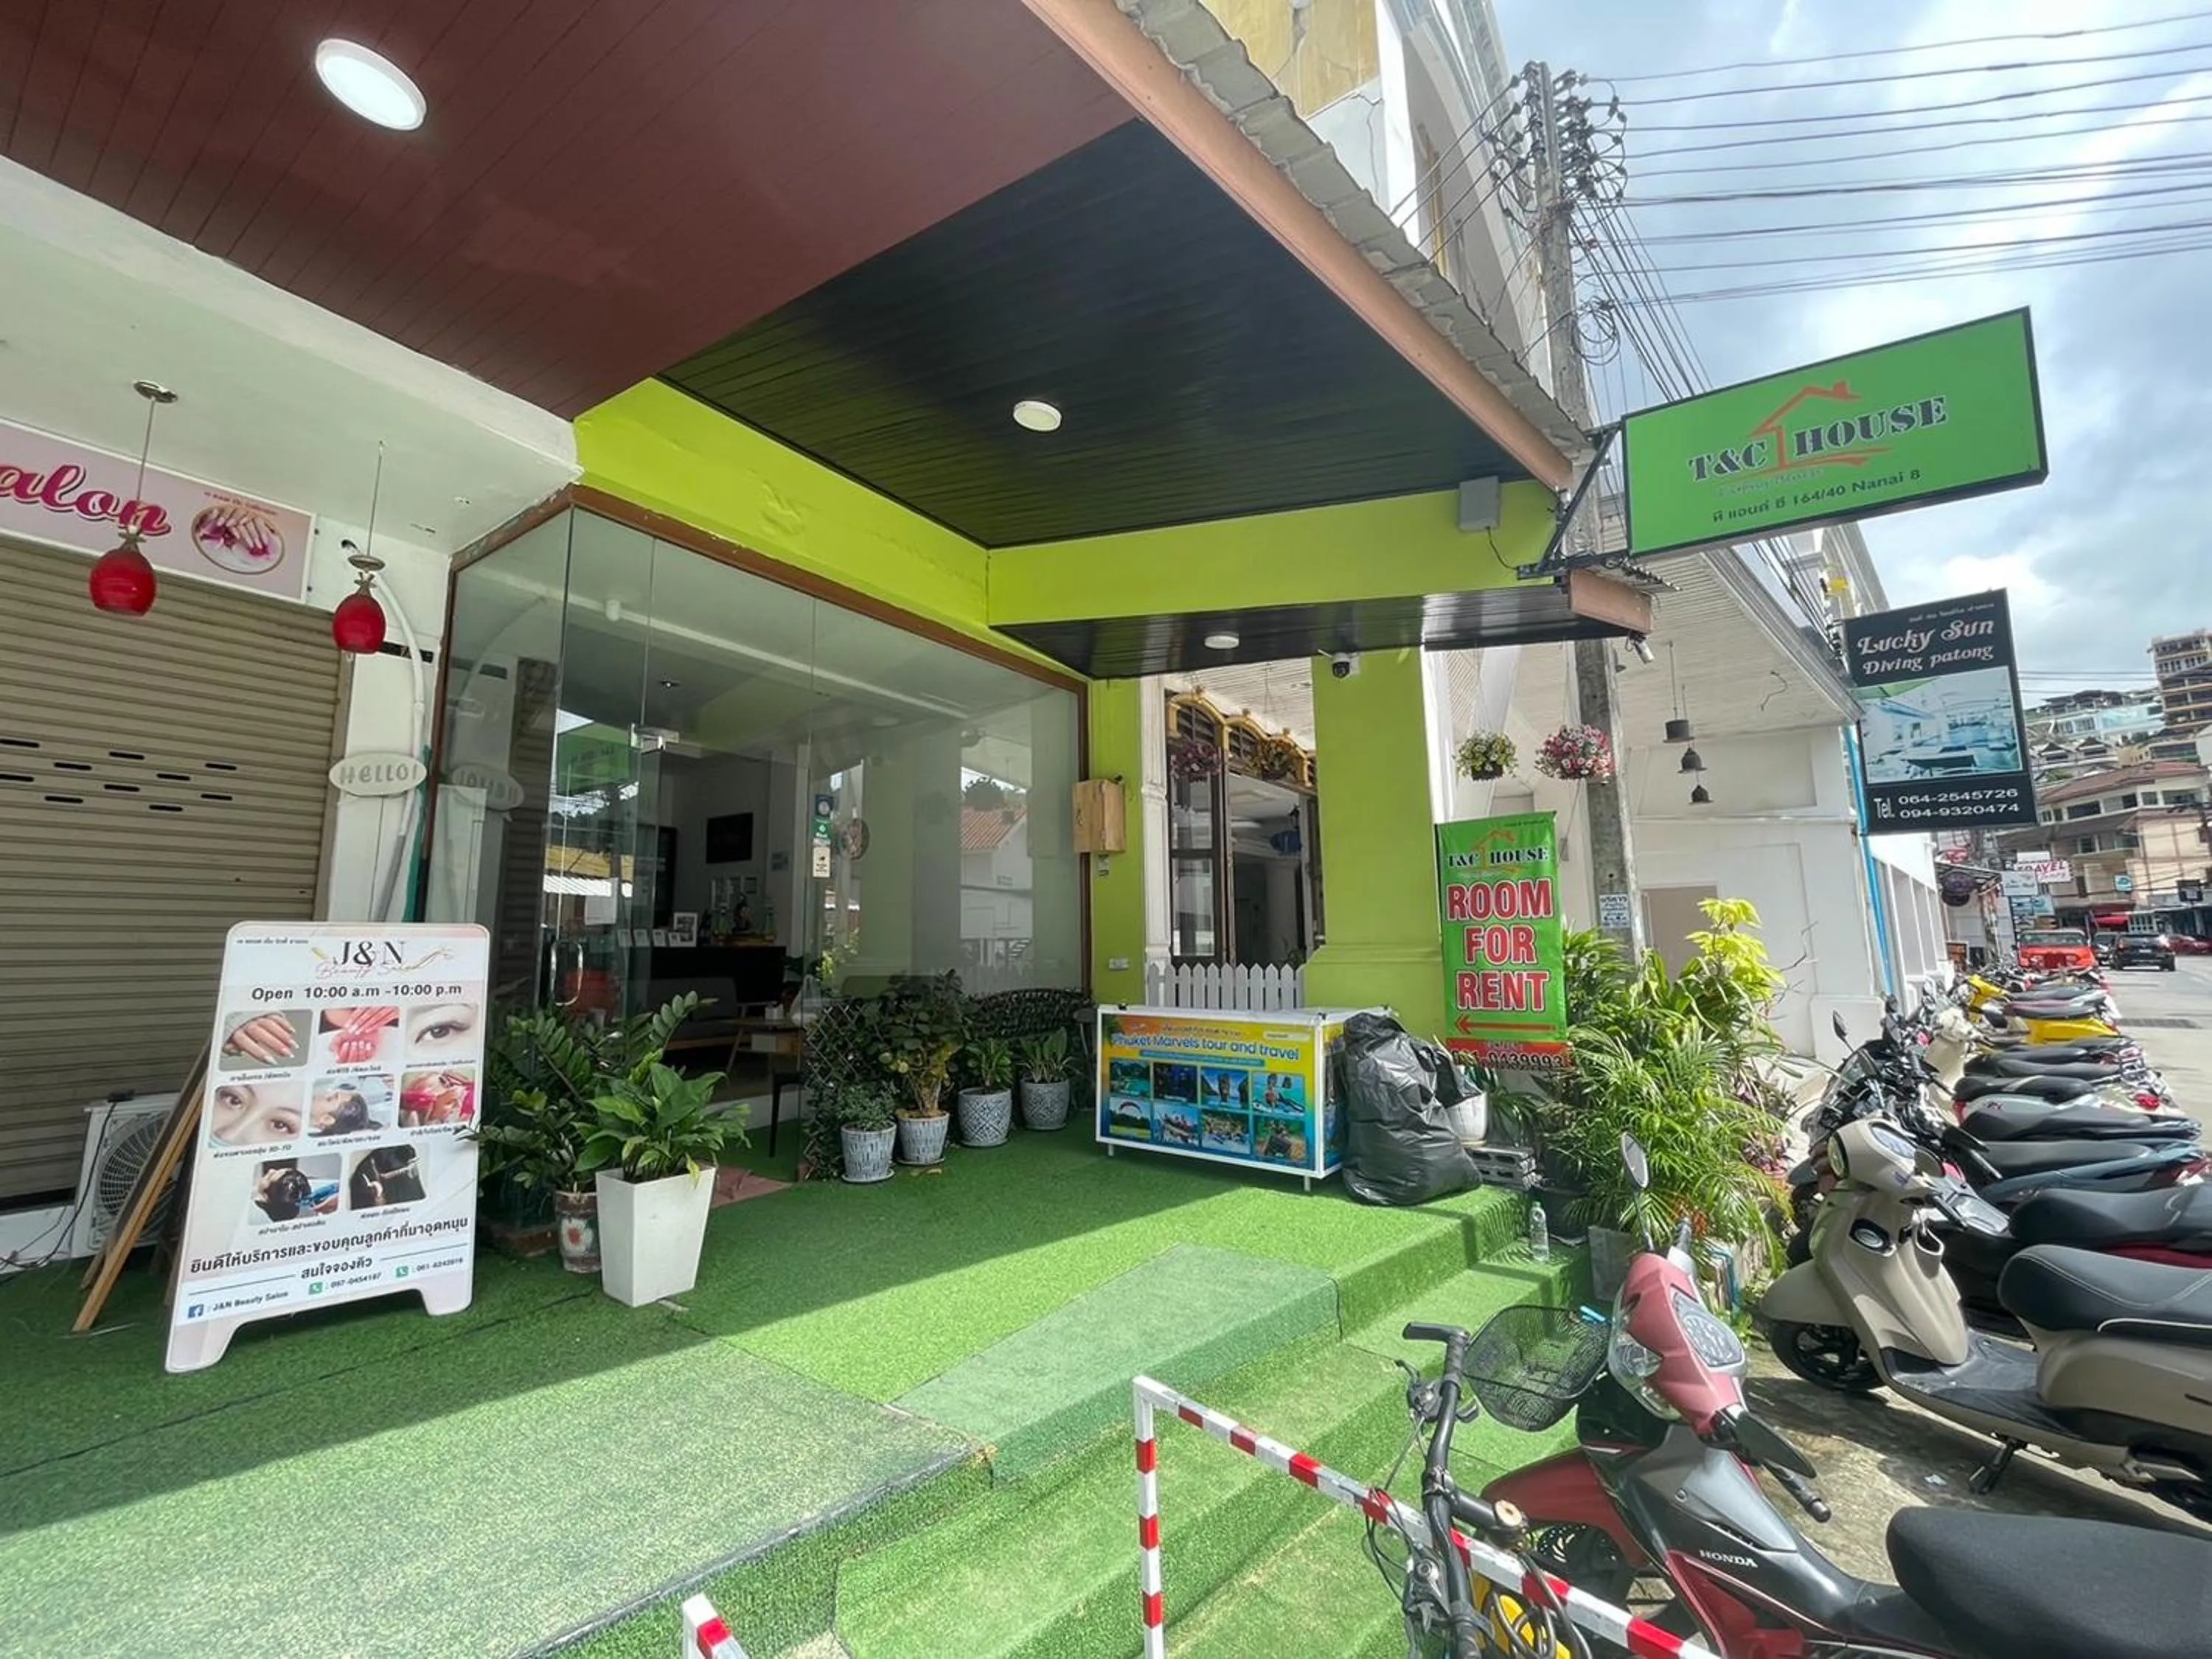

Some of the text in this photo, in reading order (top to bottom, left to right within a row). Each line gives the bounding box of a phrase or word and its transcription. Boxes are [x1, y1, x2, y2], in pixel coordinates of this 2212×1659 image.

[1688, 440, 1769, 482] T&C
[1792, 395, 1948, 457] HOUSE
[1792, 485, 1847, 506] 164/40
[1851, 470, 1905, 492] Nanai
[1910, 469, 1921, 481] 8
[1856, 619, 1994, 656] Lucky Sun
[1862, 645, 1994, 676] Diving patong
[1489, 846, 1548, 865] HOUSE
[1446, 878, 1554, 922] ROOM
[333, 941, 406, 967] J&N
[1464, 925, 1537, 967] FOR
[251, 987, 293, 1003] Open
[304, 986, 347, 999] 10:00
[352, 987, 380, 998] a.m
[436, 984, 462, 998] p.m
[1456, 971, 1549, 1012] RENT
[1153, 1035, 1199, 1049] Marvels
[1202, 1040, 1228, 1051] tour
[1229, 1040, 1256, 1054] and
[1259, 1044, 1299, 1061] travel
[1699, 1550, 1758, 1568] HONDA
